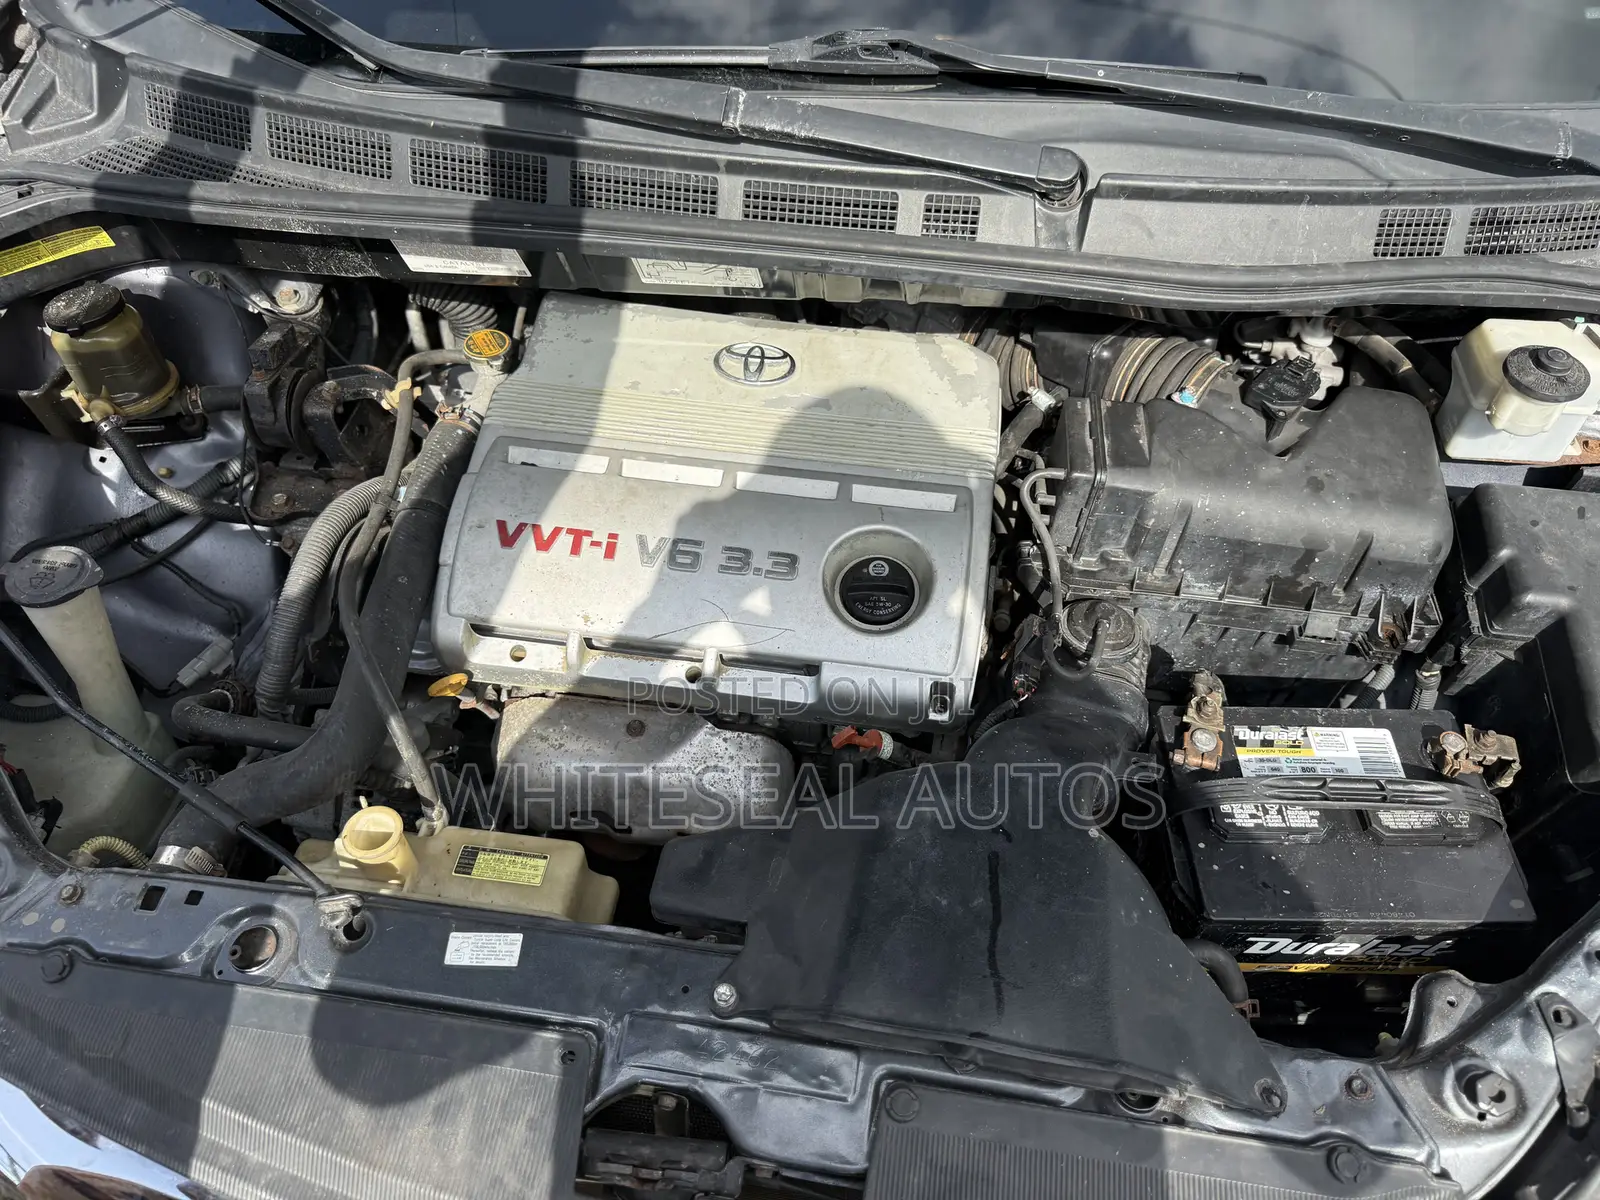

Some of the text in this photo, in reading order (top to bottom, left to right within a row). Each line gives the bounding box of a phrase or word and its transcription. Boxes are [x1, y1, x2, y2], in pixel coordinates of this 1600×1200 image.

[495, 519, 800, 581] VVT-i V6 3.3
[1238, 727, 1305, 740] Duralast
[1243, 937, 1453, 957] Duralast
